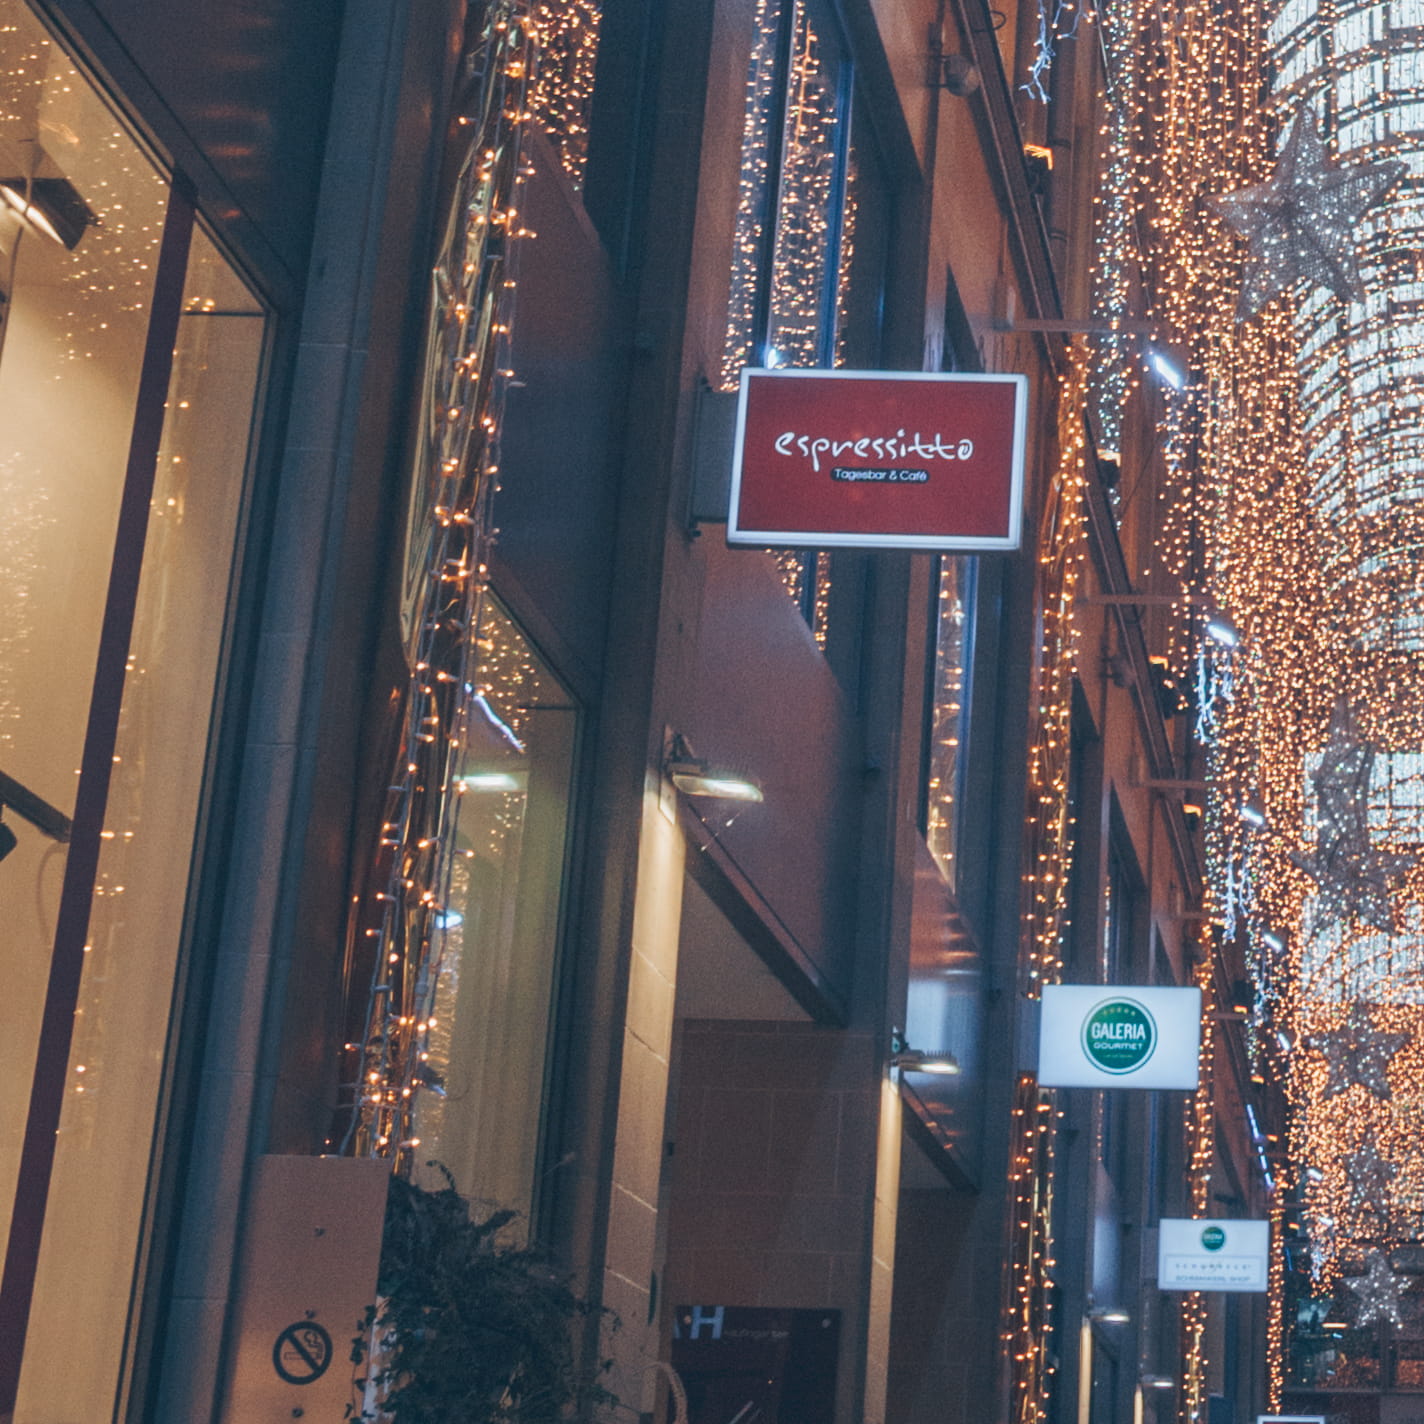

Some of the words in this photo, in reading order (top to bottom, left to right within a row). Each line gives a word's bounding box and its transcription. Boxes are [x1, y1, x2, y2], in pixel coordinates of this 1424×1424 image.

[774, 428, 974, 473] espressitto
[834, 468, 887, 482] Tagesbar
[888, 469, 898, 482] &
[899, 469, 927, 483] Café
[1091, 1022, 1146, 1040] GALERIA
[1093, 1042, 1143, 1050] GOURMET
